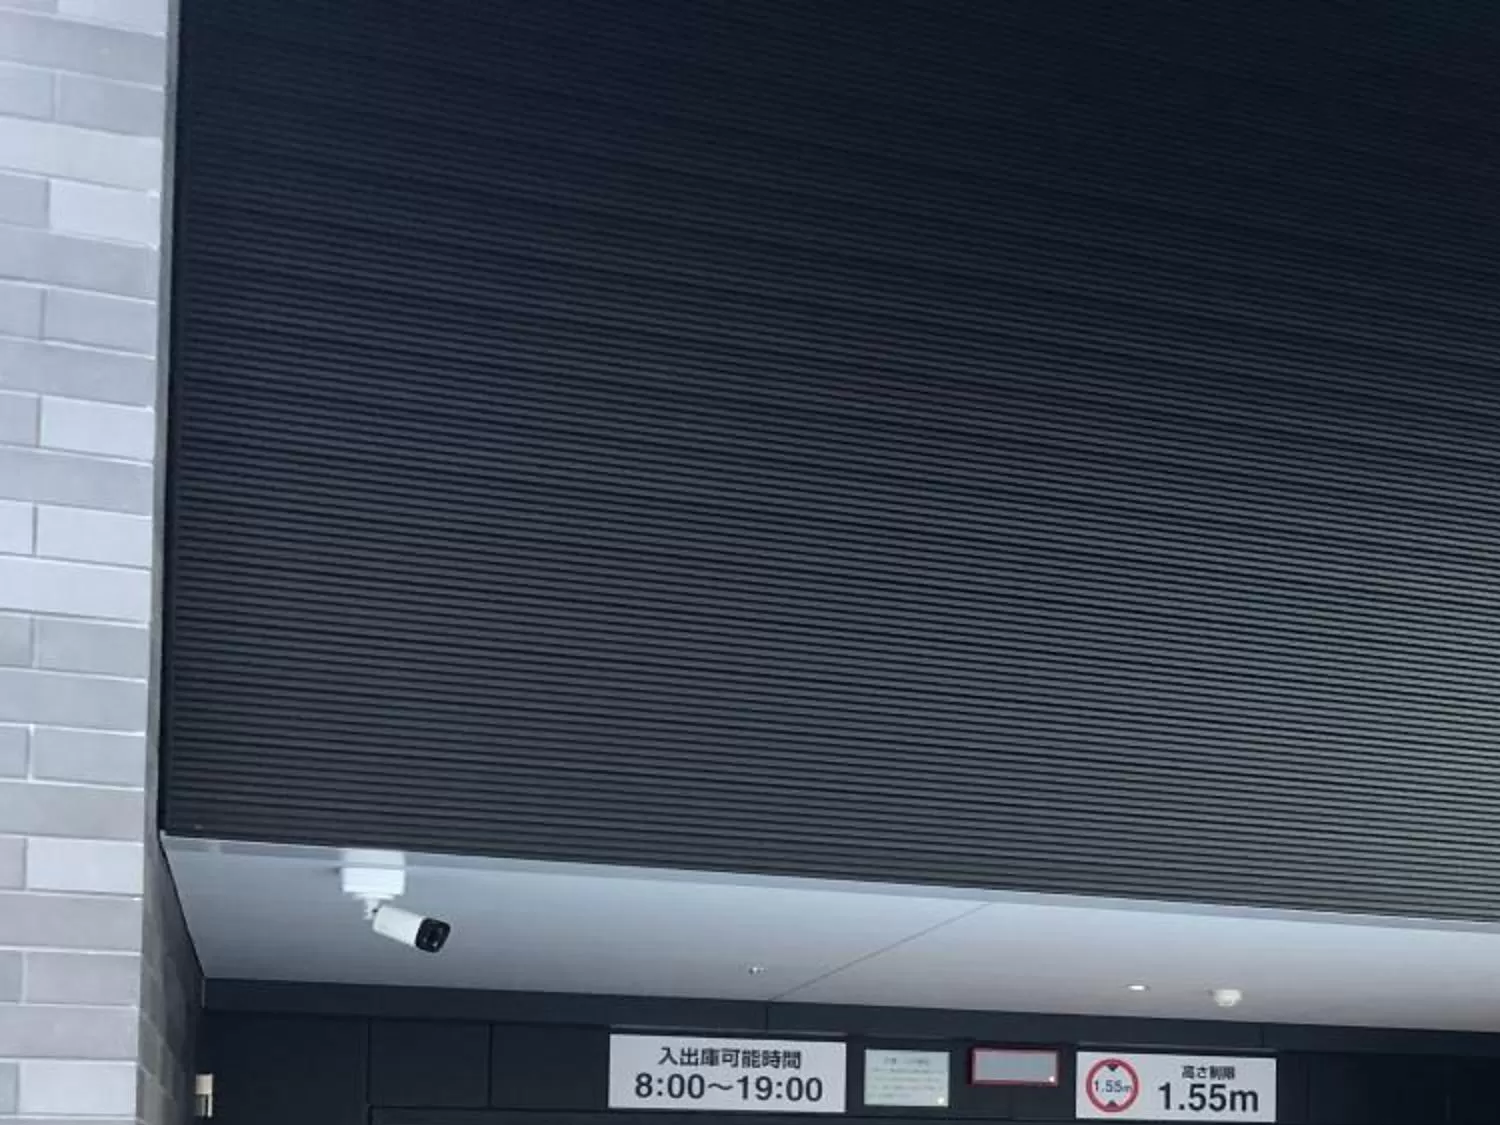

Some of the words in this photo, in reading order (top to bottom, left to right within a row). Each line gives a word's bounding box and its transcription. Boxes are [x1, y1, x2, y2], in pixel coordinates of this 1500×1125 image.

[658, 1047, 801, 1069] 入出庫可能時間
[1181, 1065, 1236, 1080] 高さ制限
[1094, 1079, 1132, 1093] 1.55m
[1158, 1082, 1259, 1113] 1.55m
